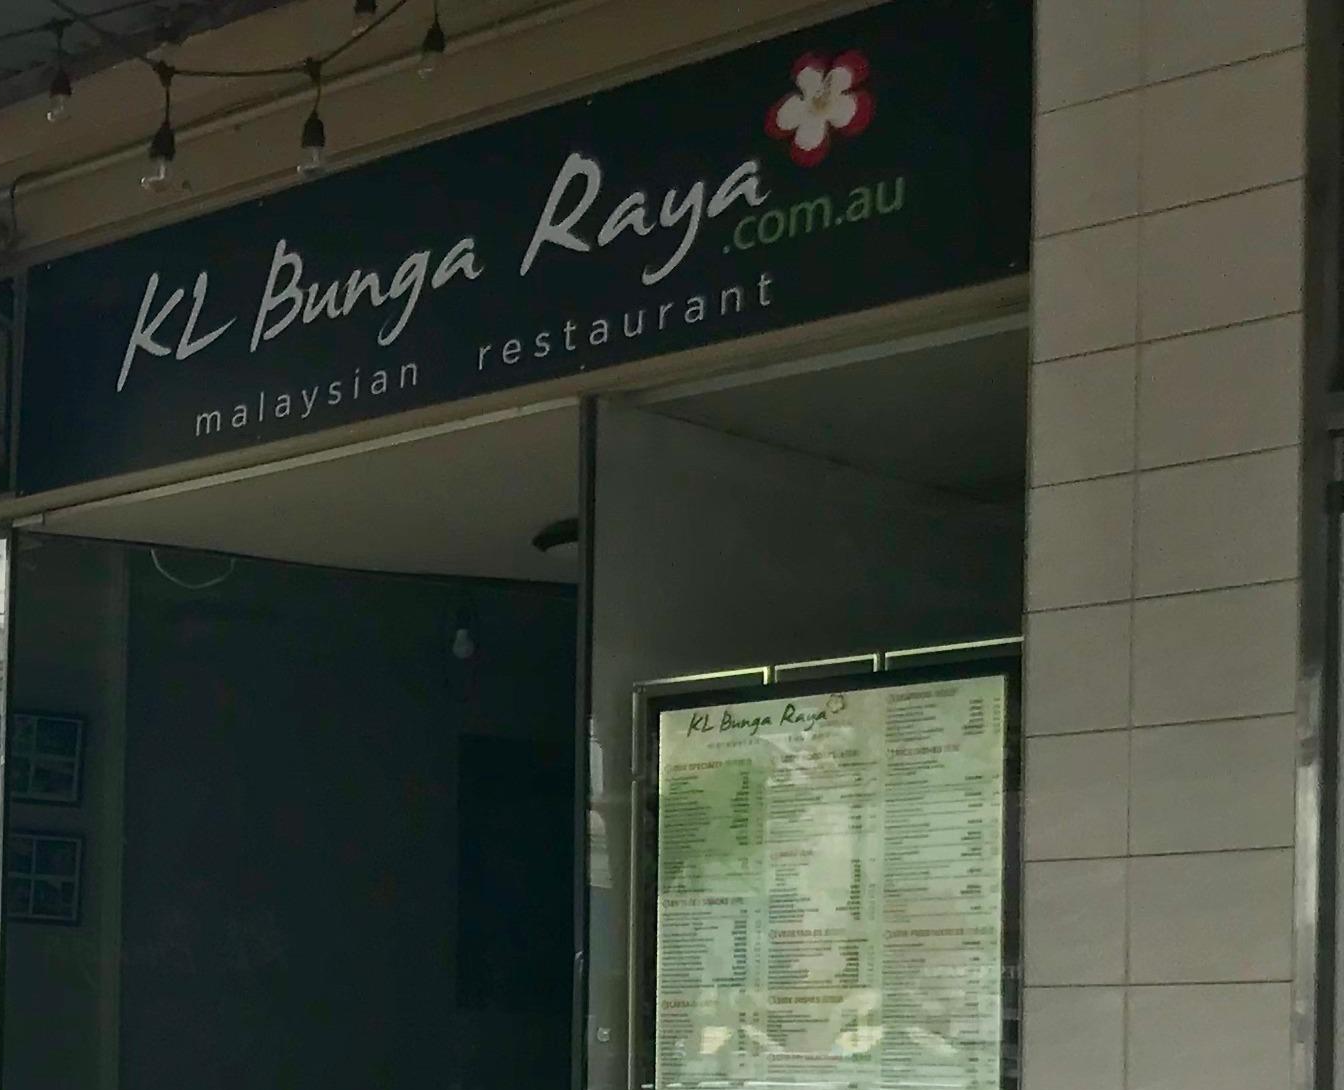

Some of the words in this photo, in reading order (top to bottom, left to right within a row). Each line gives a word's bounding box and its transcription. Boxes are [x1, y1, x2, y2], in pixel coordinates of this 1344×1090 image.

[117, 272, 236, 391] KL
[250, 238, 484, 351] Bunga
[519, 152, 771, 286] Raya
[722, 175, 906, 254] .com.au
[195, 361, 417, 436] malaysian
[477, 272, 773, 371] restaurant
[686, 711, 714, 738] KL
[719, 709, 772, 737] Bunga
[779, 703, 828, 732] Raya
